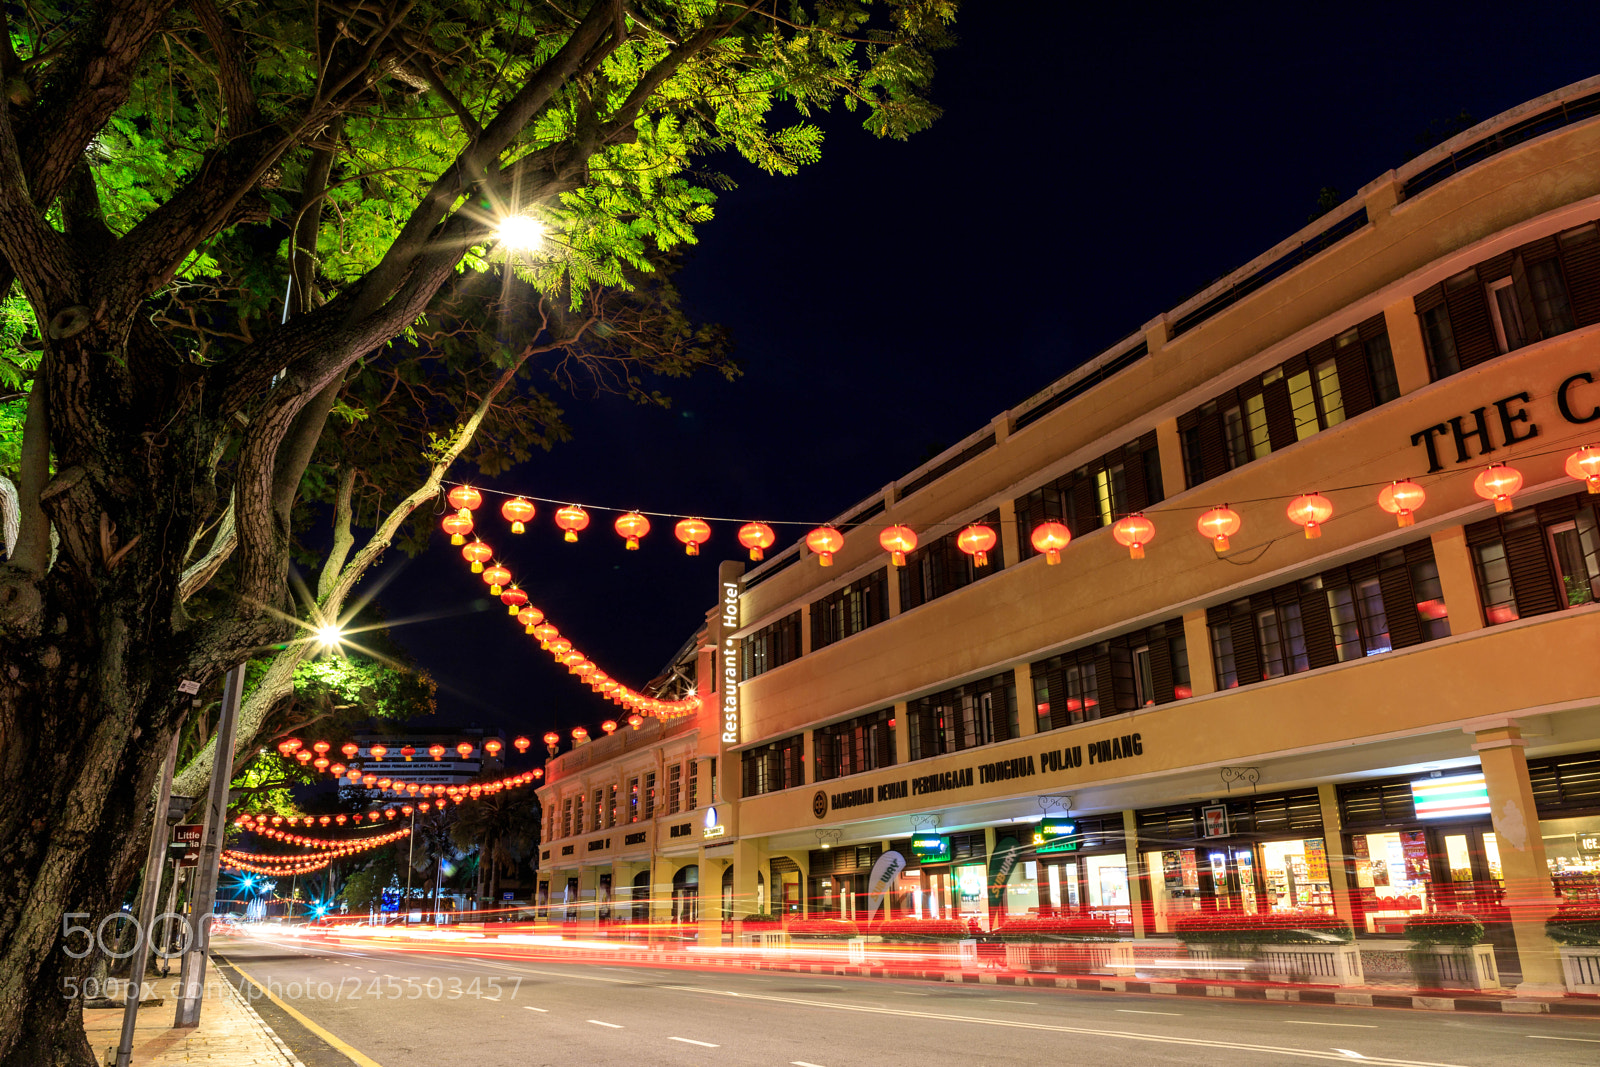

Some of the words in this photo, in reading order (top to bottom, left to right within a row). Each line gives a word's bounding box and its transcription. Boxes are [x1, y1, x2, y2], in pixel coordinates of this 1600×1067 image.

[1410, 391, 1539, 474] THE
[723, 582, 738, 627] Hotel
[722, 649, 737, 743] Restaurant
[831, 787, 874, 810] BANGUNAN
[877, 780, 908, 803] DEWAN
[912, 767, 973, 797] PERNIAGAAN
[978, 755, 1035, 784] TIONGHUA
[1040, 746, 1082, 774] PULAU
[1088, 733, 1143, 765] PINANG
[870, 858, 900, 903] SUBWAY
[992, 845, 1017, 899] SUBWAY
